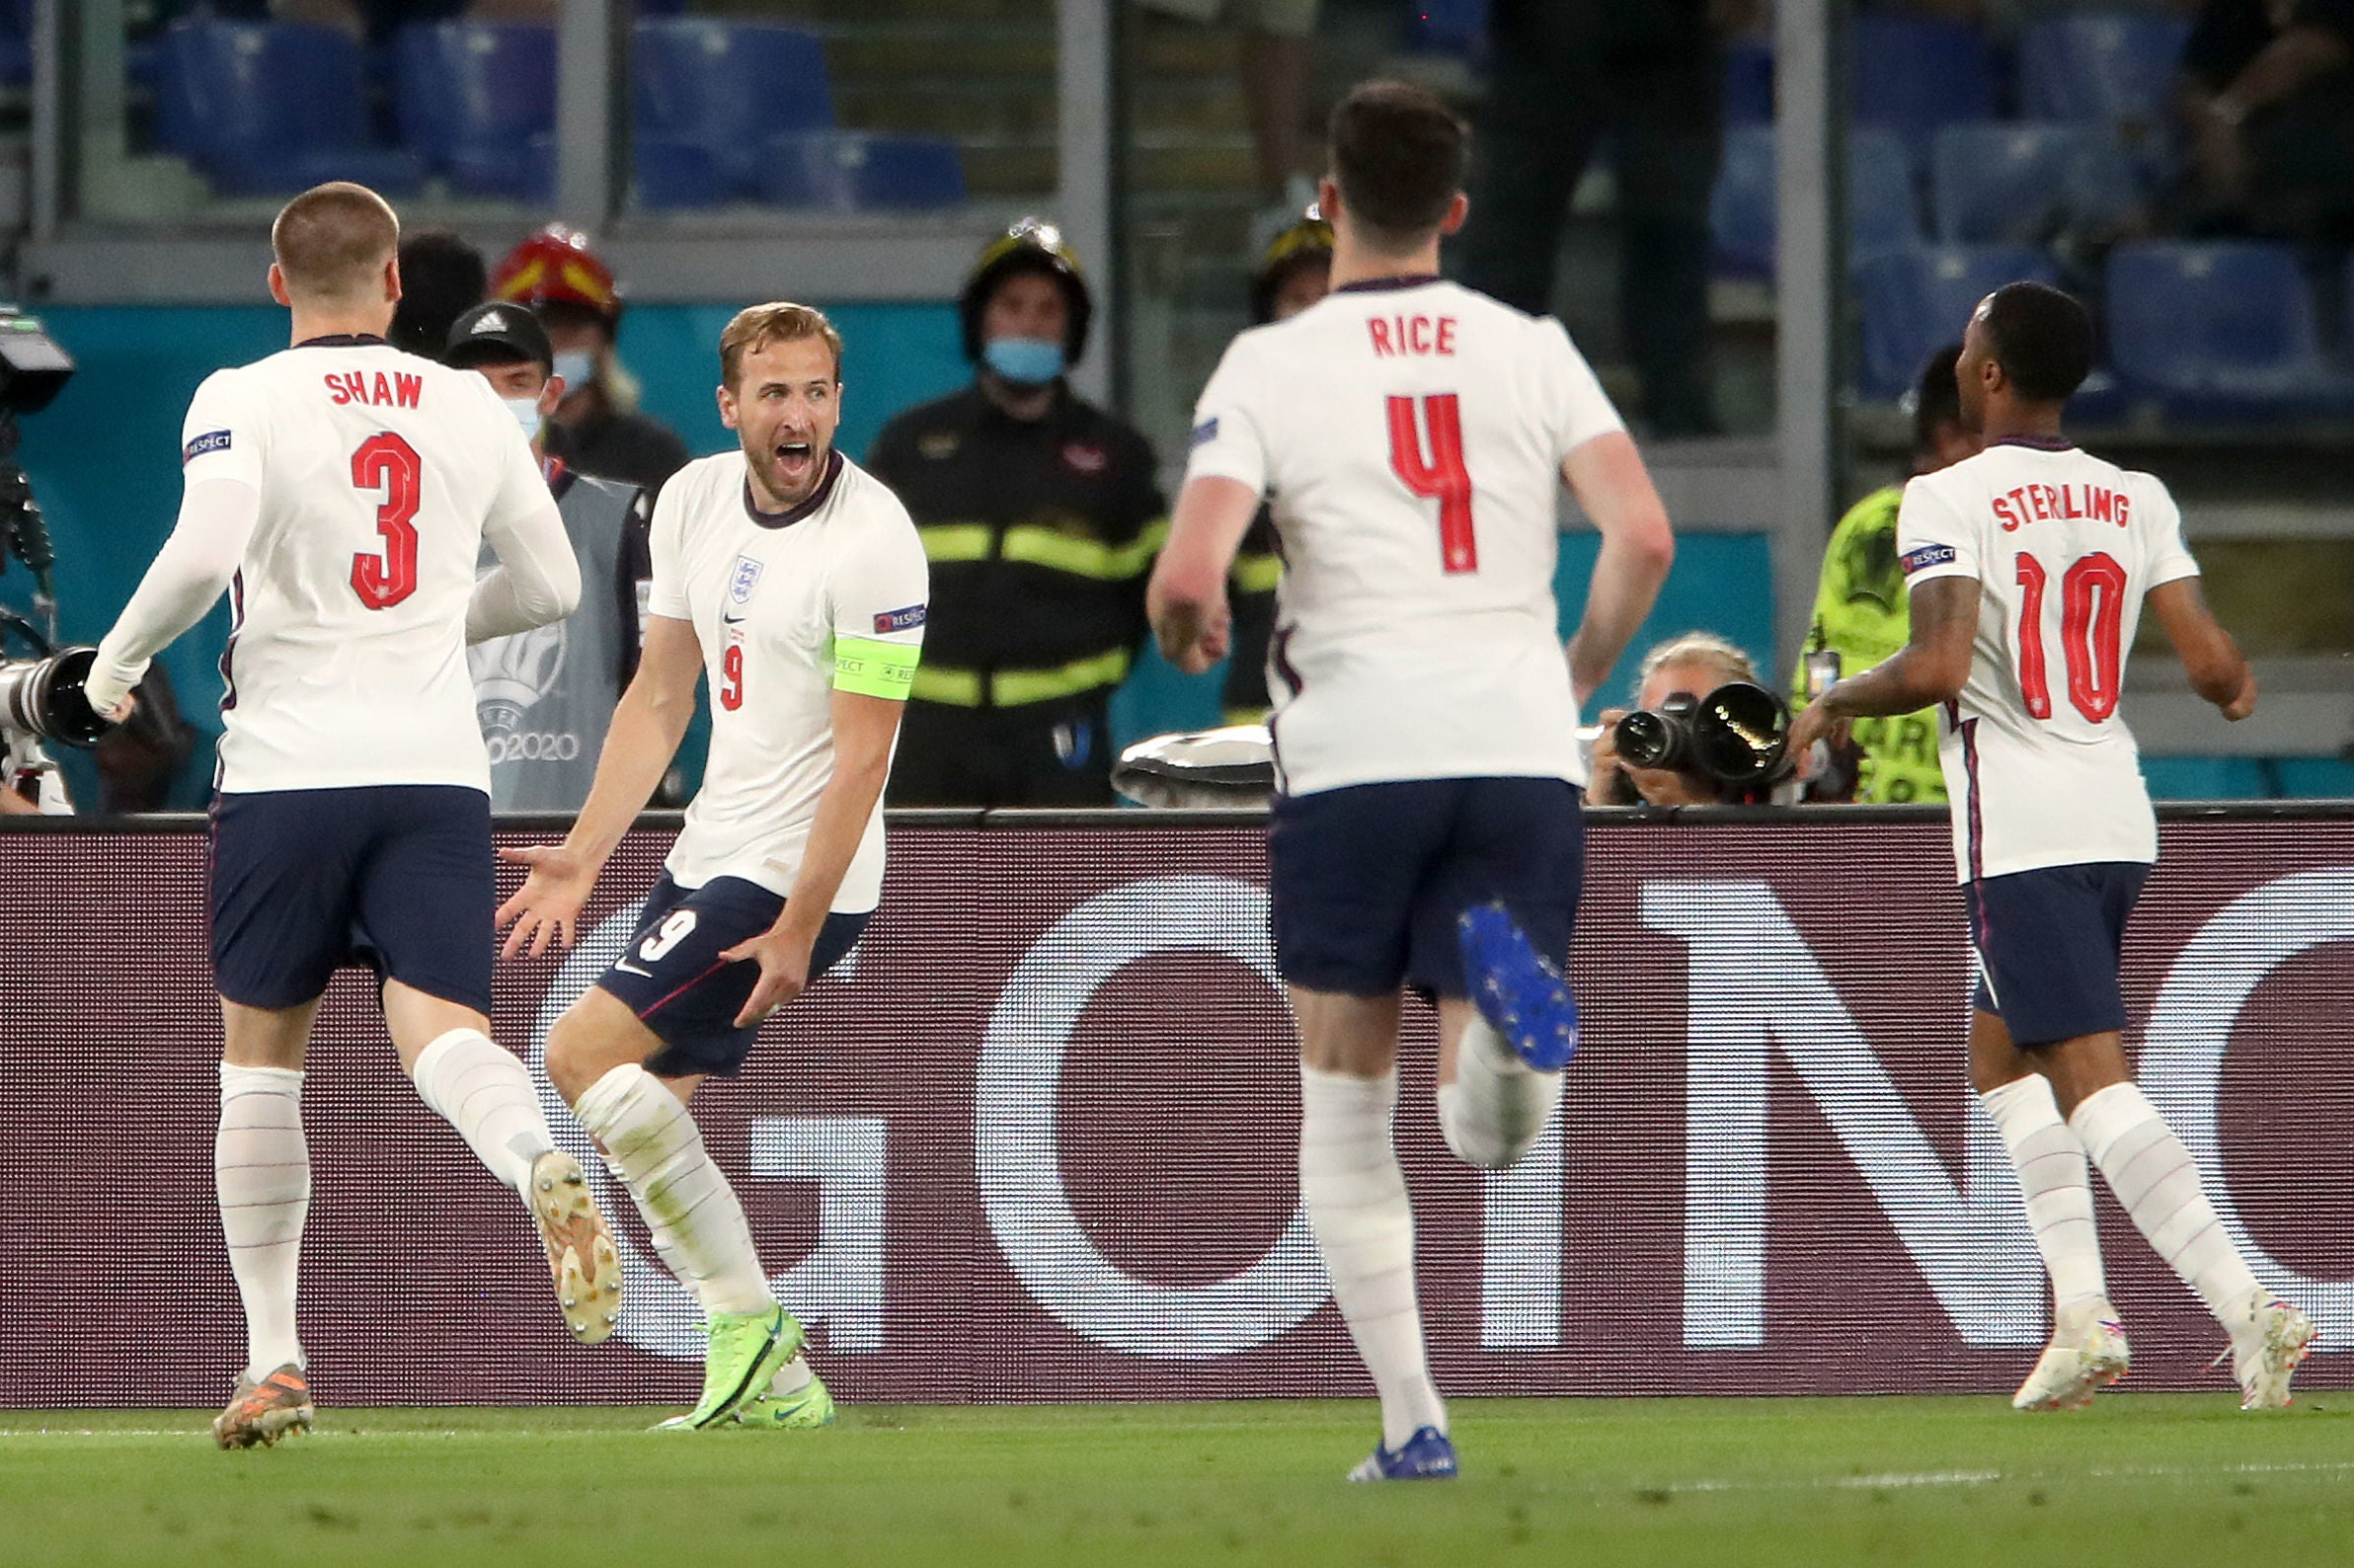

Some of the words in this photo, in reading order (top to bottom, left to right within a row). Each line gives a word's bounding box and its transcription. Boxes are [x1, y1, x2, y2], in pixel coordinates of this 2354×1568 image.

[1368, 315, 1457, 357] RICE
[324, 370, 423, 410] SHAW
[189, 435, 230, 454] RESPECT
[1384, 393, 1478, 573] 4
[1992, 483, 2130, 533] STERLING
[350, 431, 422, 611] 3
[1913, 548, 1954, 566] RESPECT
[892, 609, 927, 627] RESPEC
[2014, 551, 2128, 725] 10
[720, 644, 744, 712] 9
[639, 908, 697, 963] 9
